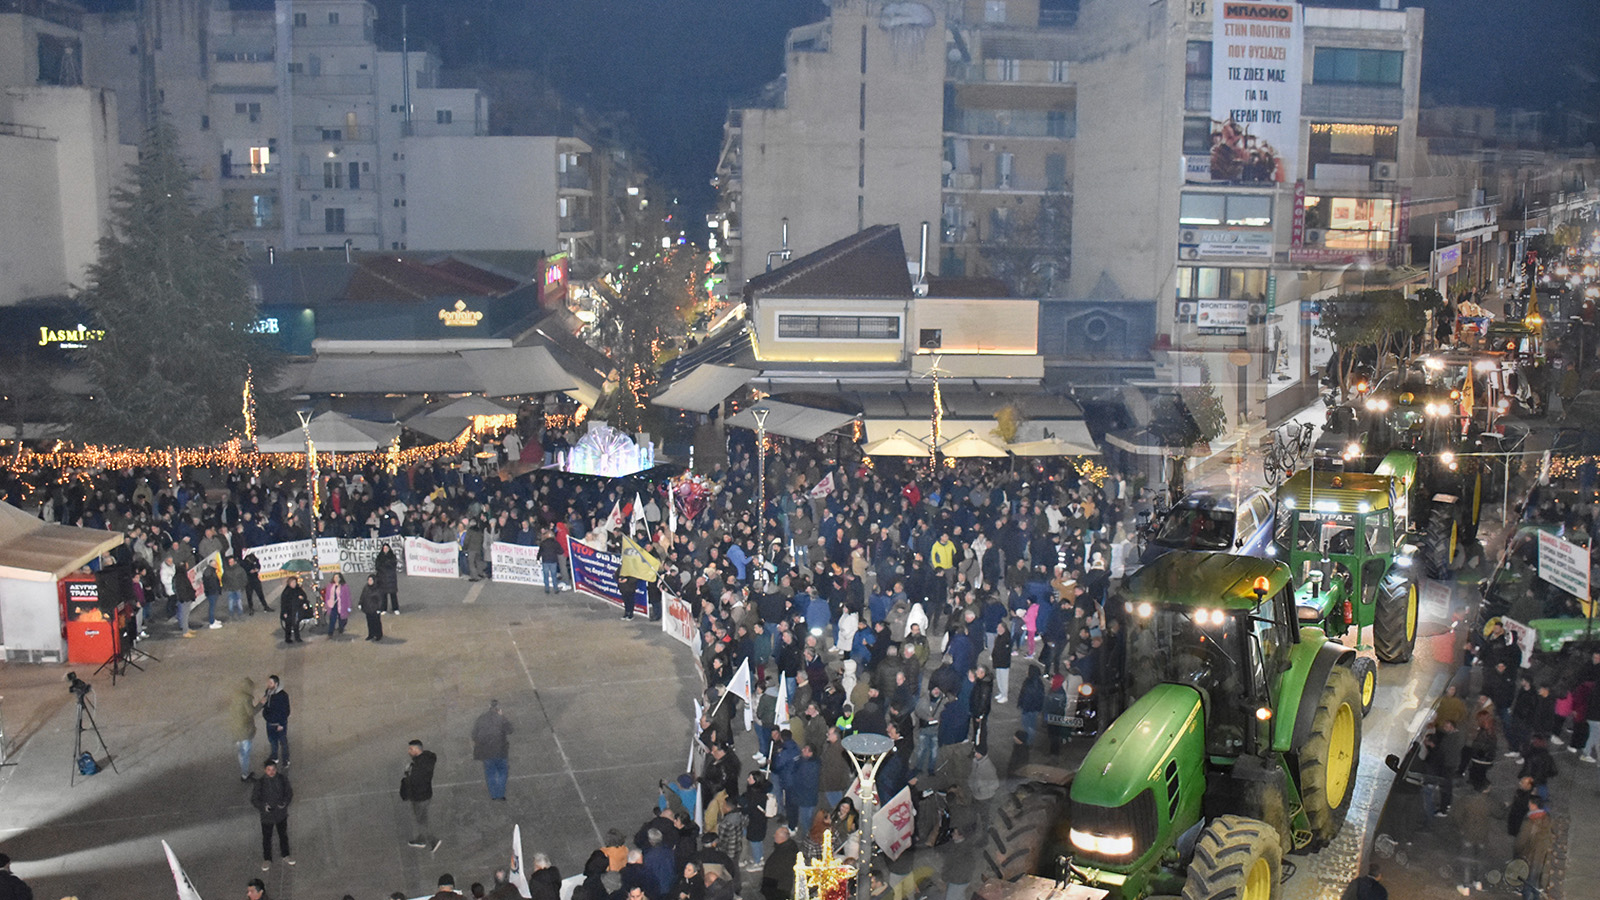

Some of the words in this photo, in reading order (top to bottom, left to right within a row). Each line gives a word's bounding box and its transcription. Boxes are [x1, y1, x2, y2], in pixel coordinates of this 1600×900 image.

[1227, 6, 1289, 19] ΜΠΛΟΚΟ
[1225, 23, 1248, 37] ΣΤΗΝ
[1250, 24, 1291, 39] ΠΟΛΙΤΙΚΗ
[1228, 45, 1246, 58] ΠΟΥ
[1249, 45, 1287, 60] ΘΥΣΙΑΖΕΙ
[1228, 67, 1241, 80] ΤΙΣ
[1243, 68, 1264, 81] ΖΩΕΣ
[1267, 69, 1286, 82] ΜΑΣ
[1245, 90, 1257, 101] ΓΙΑ
[1259, 90, 1268, 101] ΤΑ
[1230, 109, 1258, 123] ΚΕΡΔΗ
[1261, 110, 1282, 124] ΤΟΥΣ
[1200, 302, 1248, 310] ΦΡΟΝΤΙΣΤΗΡΙΟ
